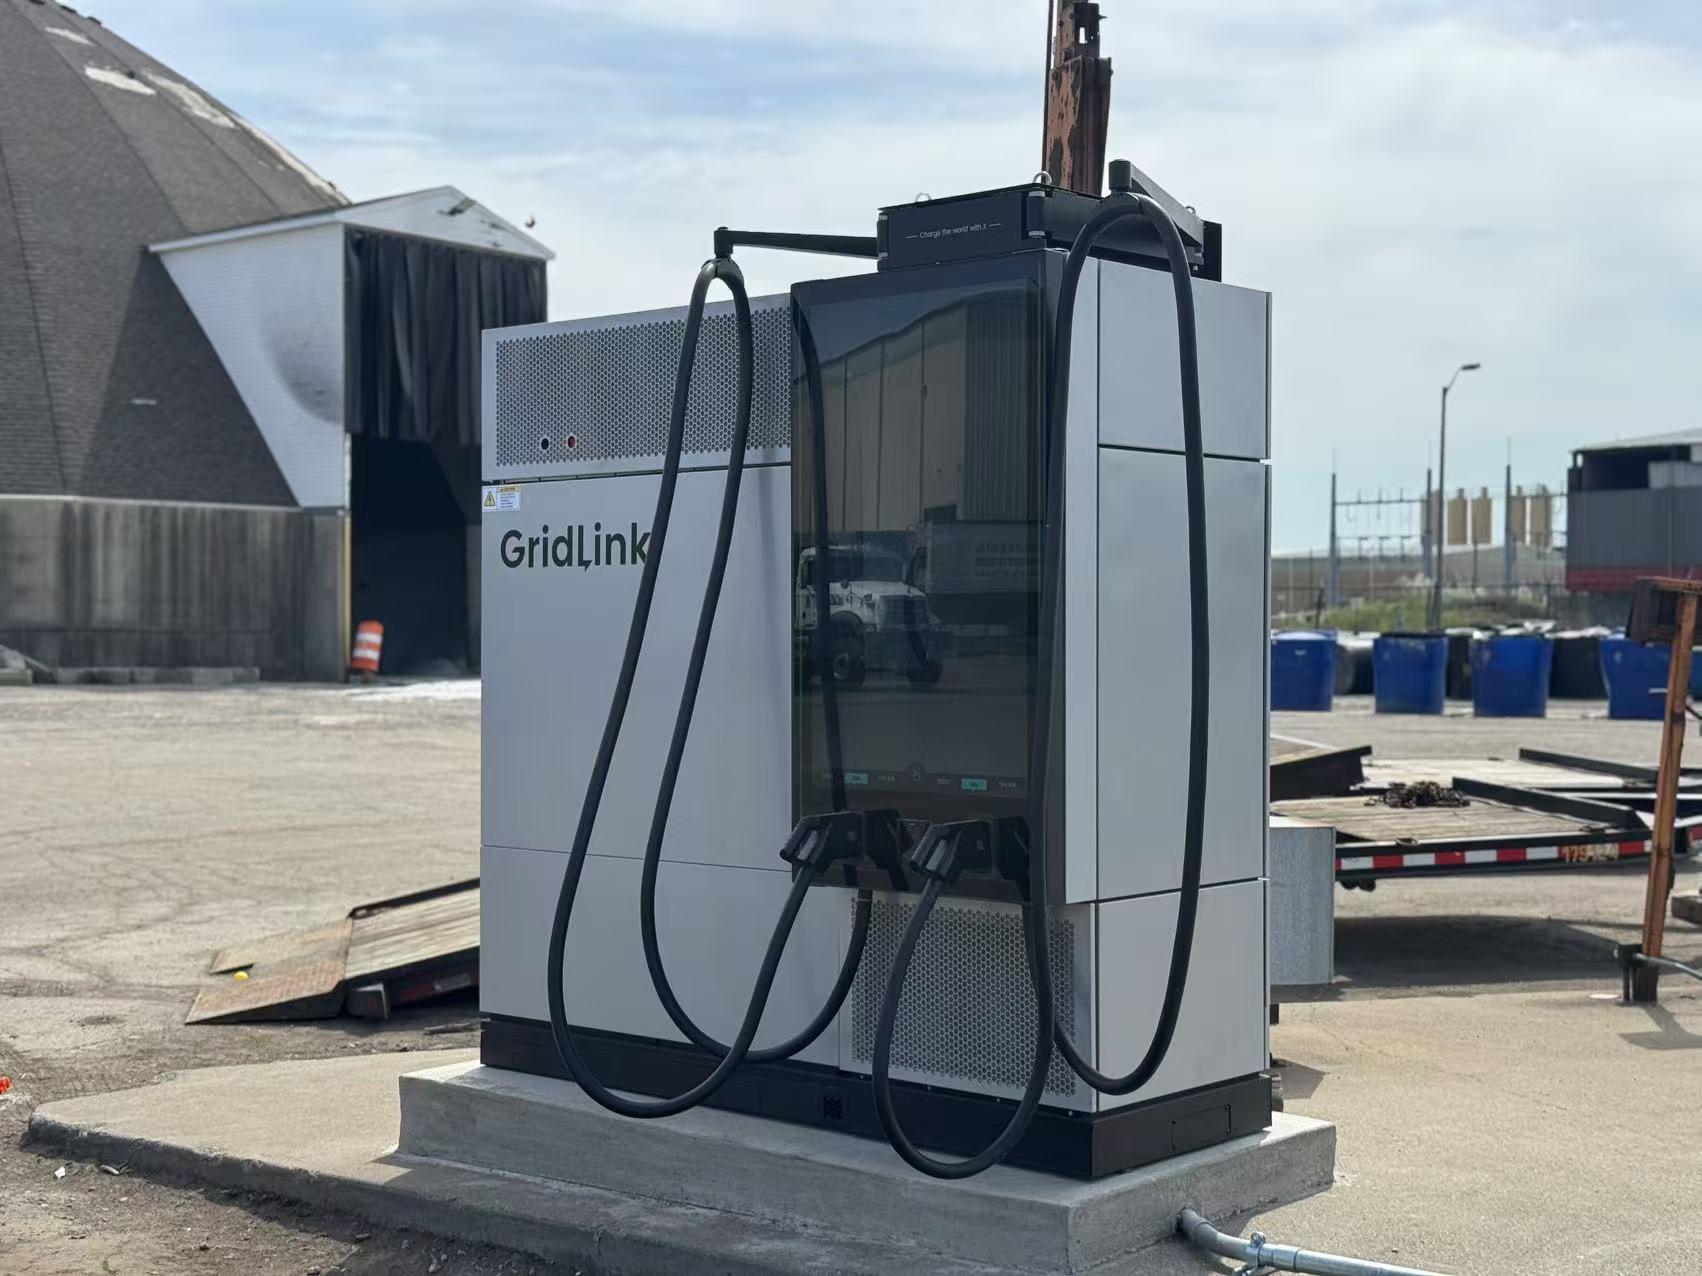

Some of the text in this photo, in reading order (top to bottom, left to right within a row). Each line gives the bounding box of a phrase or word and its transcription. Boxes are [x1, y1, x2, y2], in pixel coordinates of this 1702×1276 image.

[919, 230, 941, 239] Charge
[952, 225, 969, 234] world
[969, 223, 982, 231] with
[500, 521, 651, 572] GridLink
